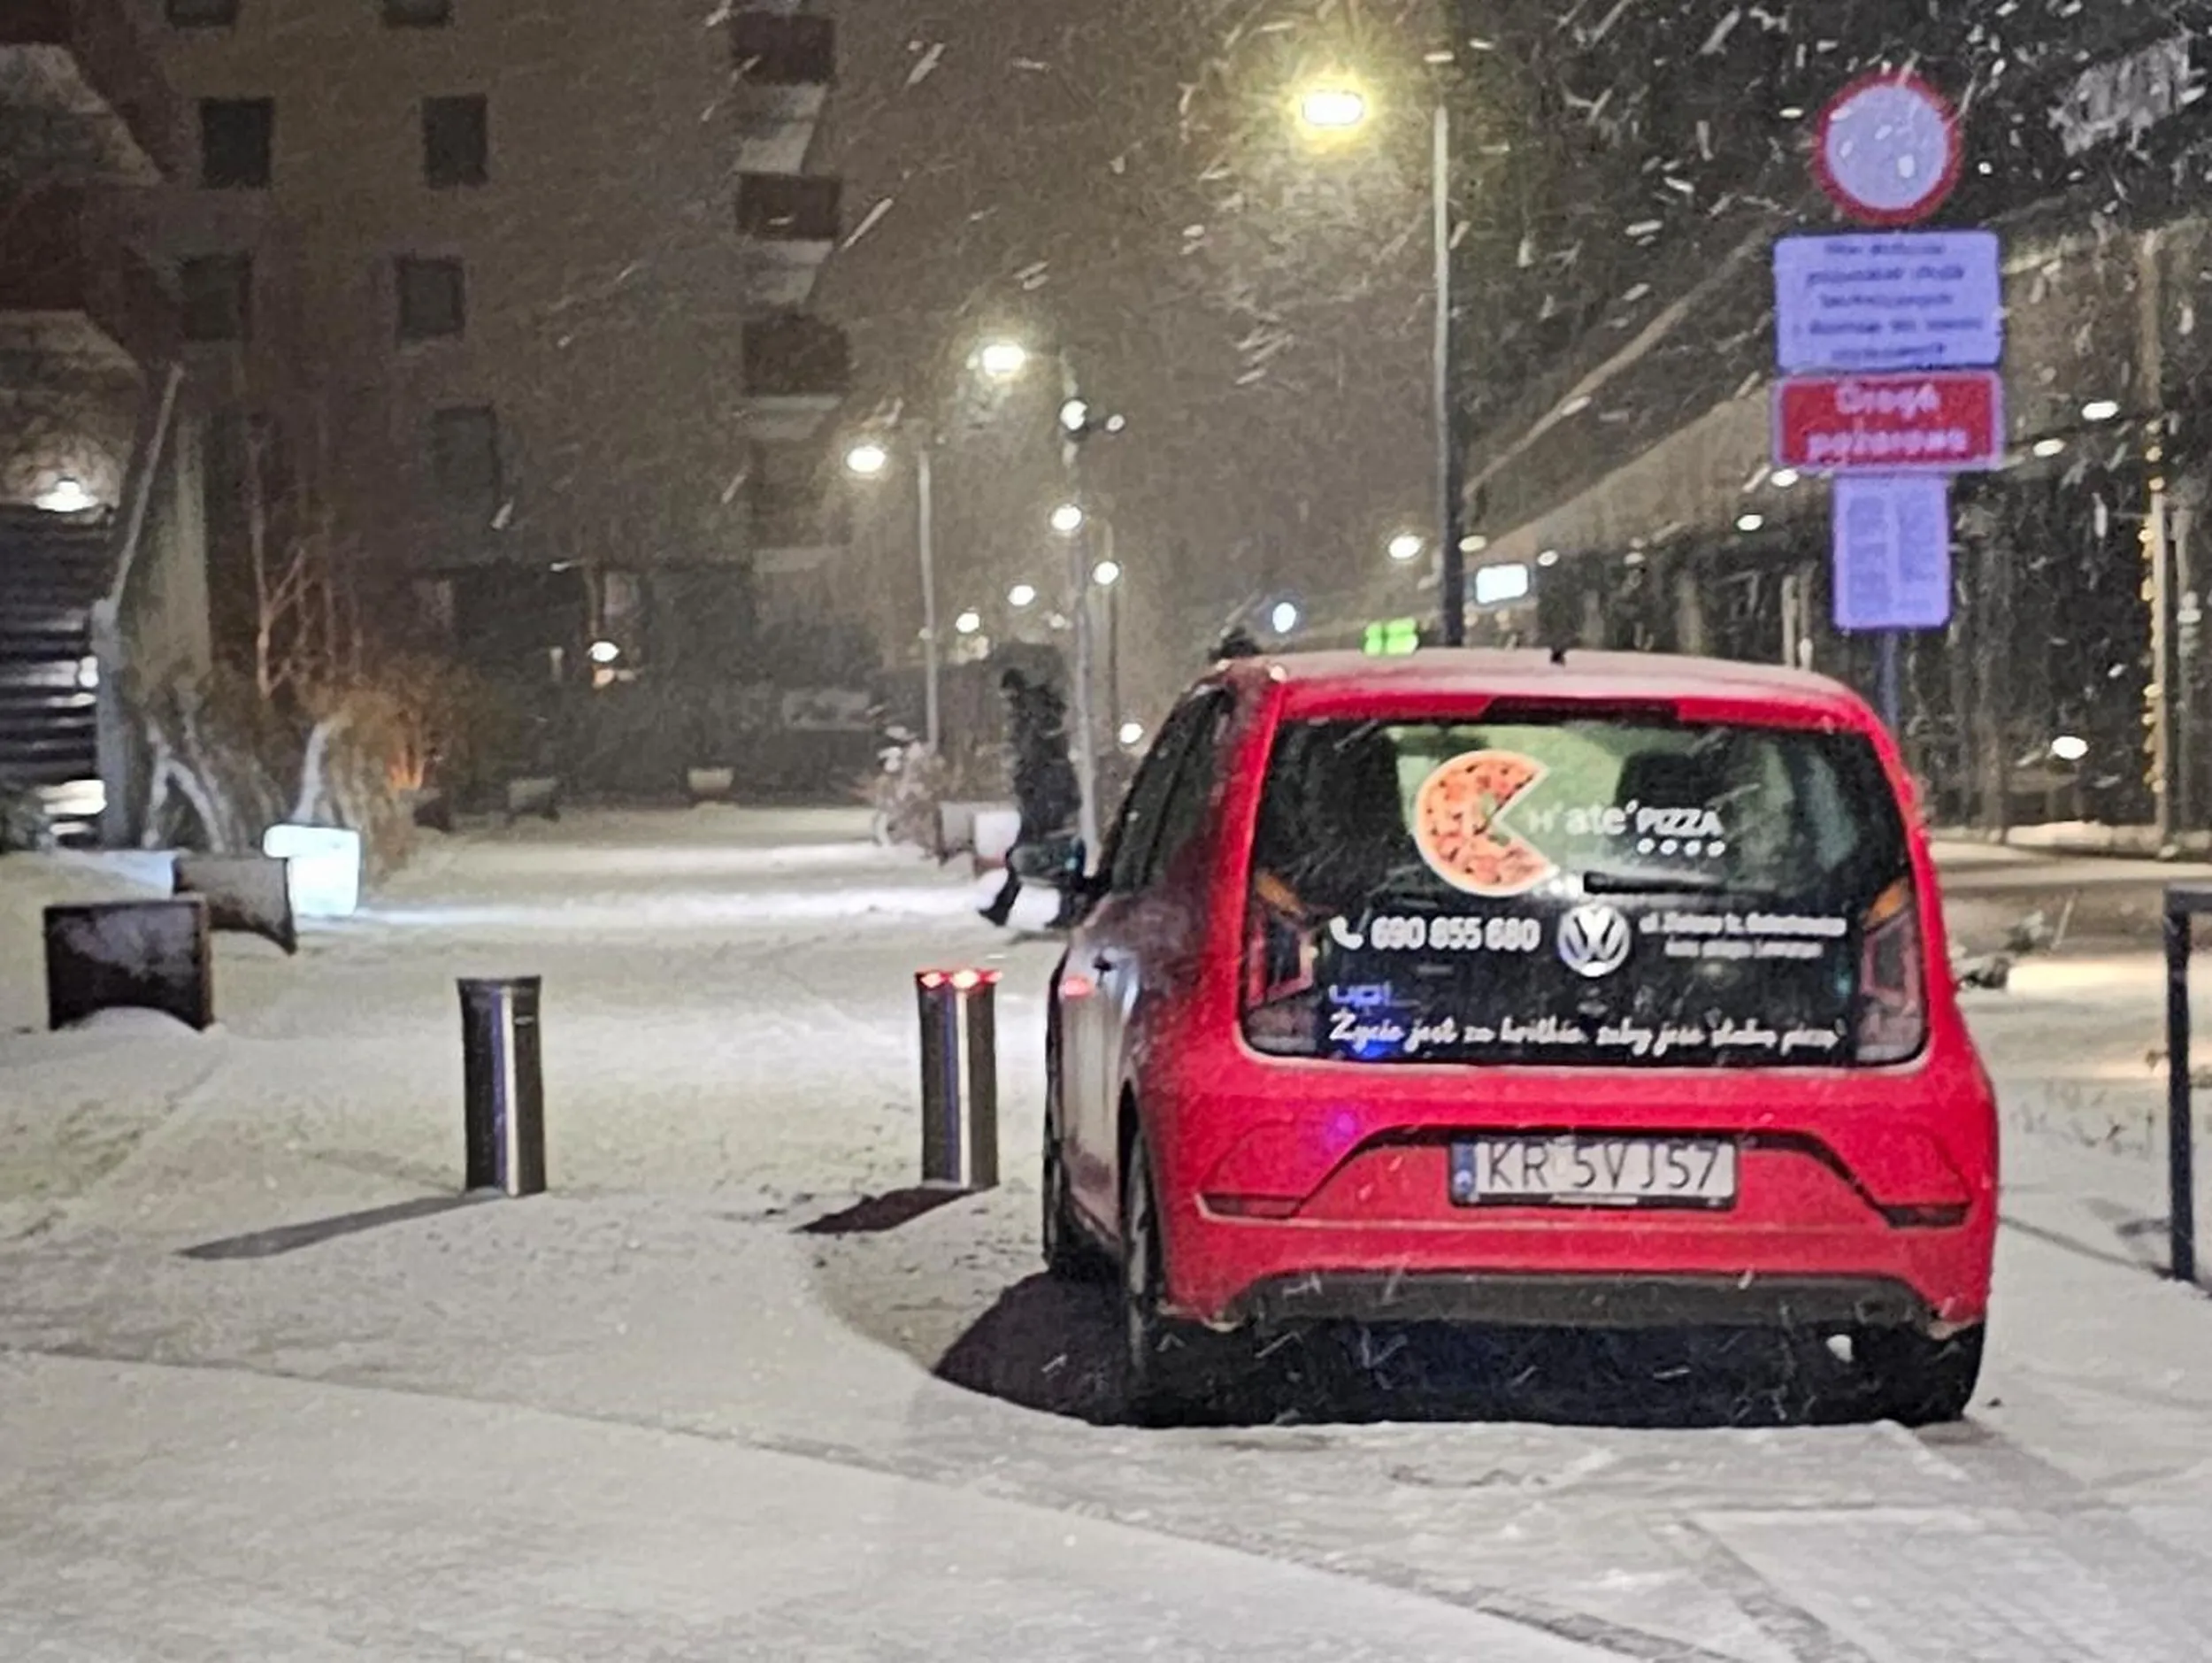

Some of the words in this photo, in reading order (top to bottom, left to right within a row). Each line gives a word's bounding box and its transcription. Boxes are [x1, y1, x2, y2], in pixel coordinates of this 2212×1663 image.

[1637, 806, 1724, 837] PIZZA
[1488, 1143, 1549, 1188] KR
[1570, 1143, 1719, 1190] 5VJ57
